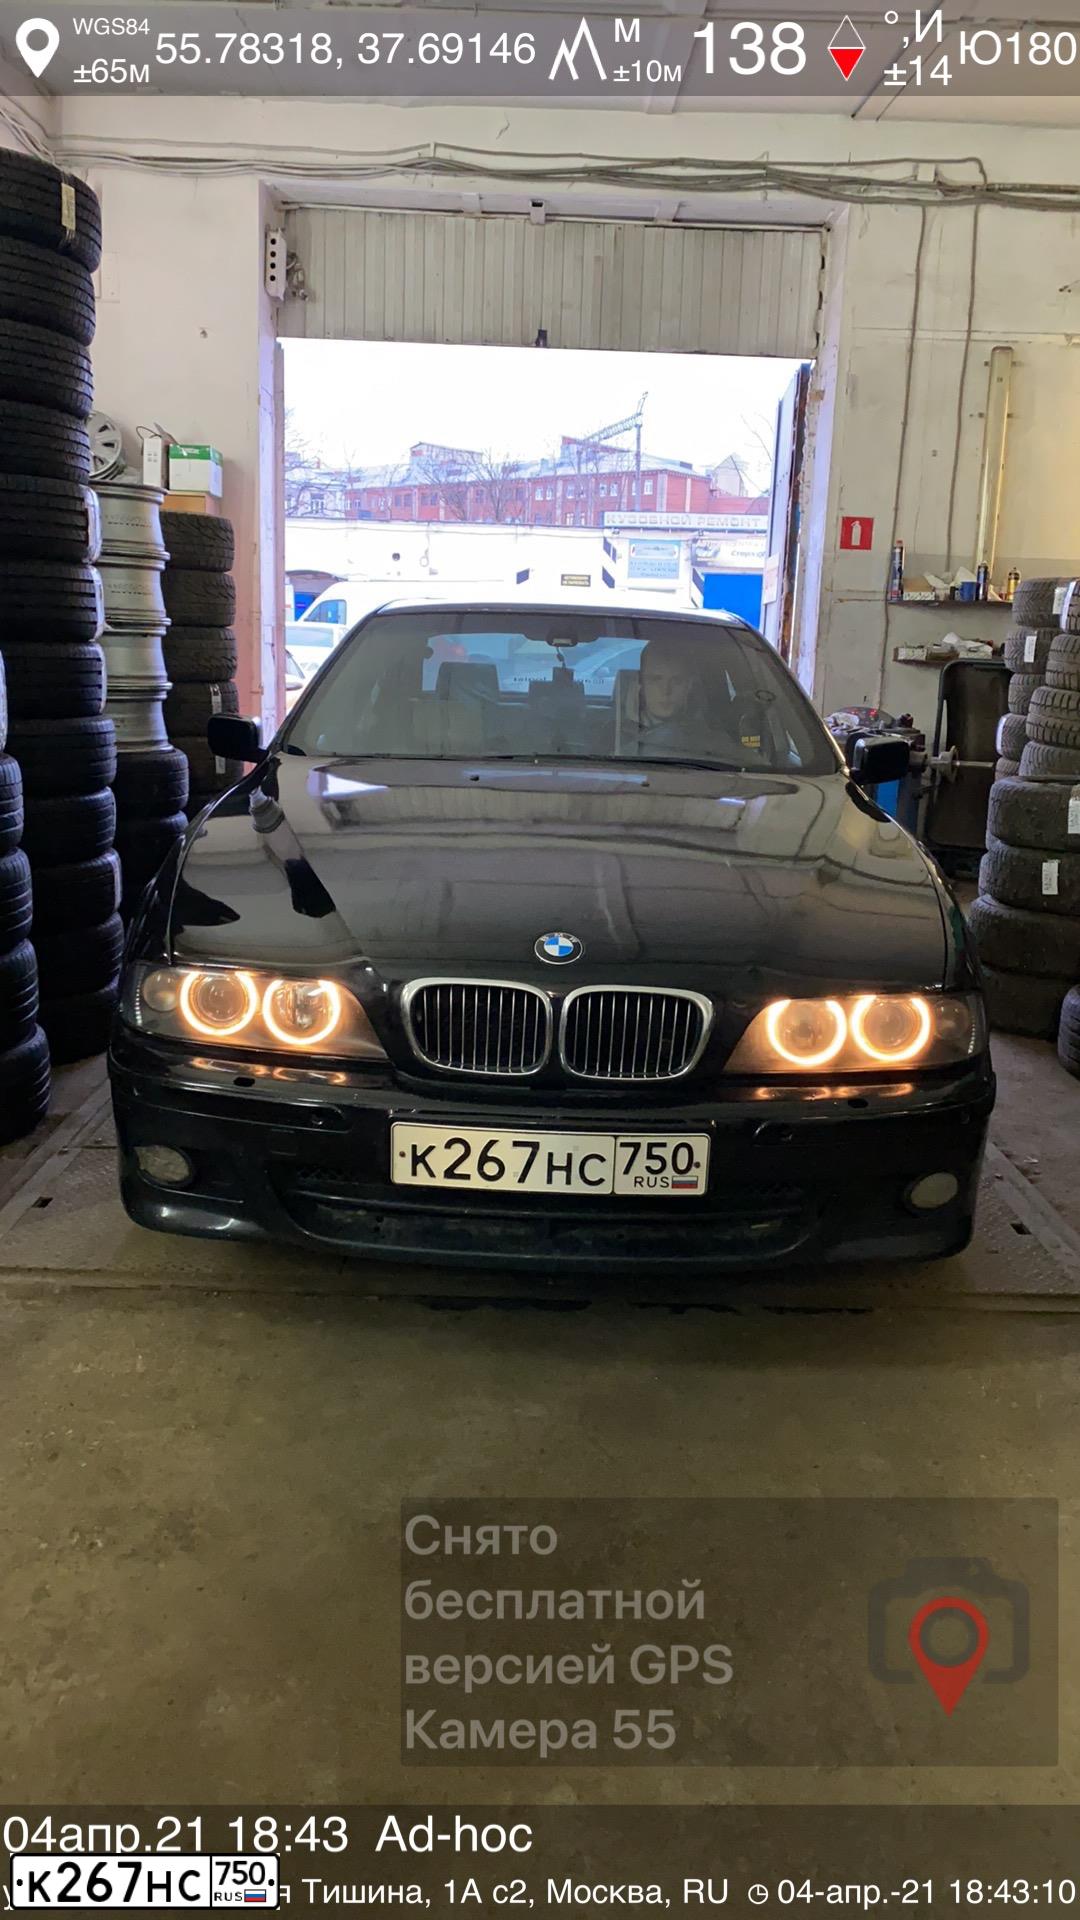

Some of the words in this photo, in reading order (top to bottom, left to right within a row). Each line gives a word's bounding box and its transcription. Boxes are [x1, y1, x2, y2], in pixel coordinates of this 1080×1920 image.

[606, 513, 692, 526] КУЗОВНОЙ
[697, 516, 761, 528] РЕМОНТ
[619, 1142, 694, 1175] 750
[633, 1176, 669, 1189] RUS
